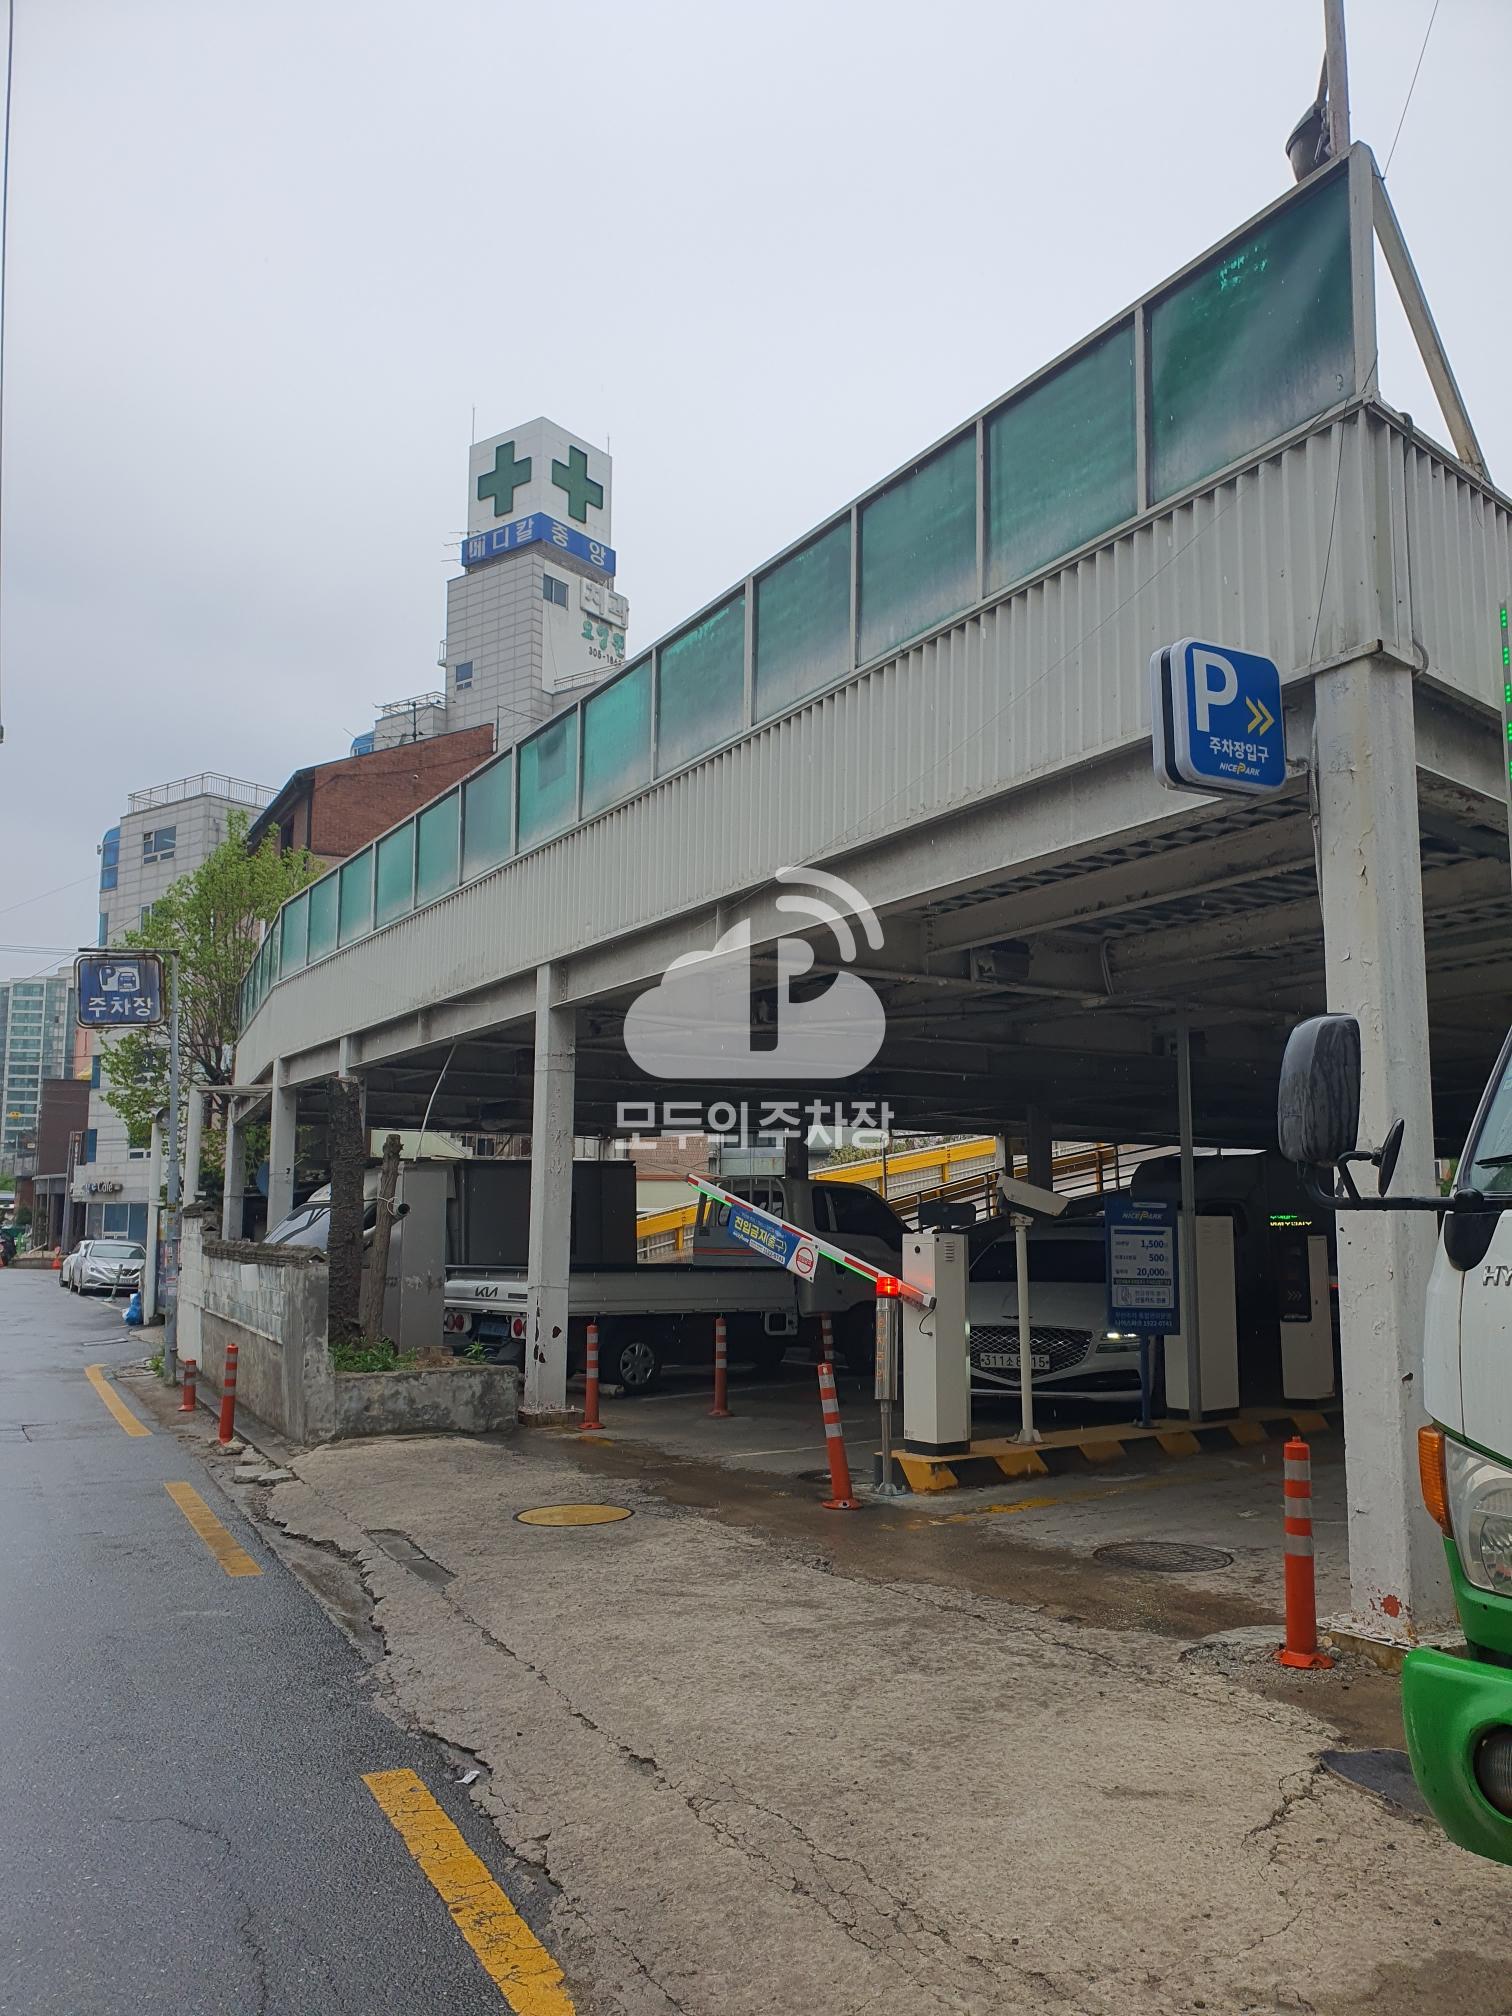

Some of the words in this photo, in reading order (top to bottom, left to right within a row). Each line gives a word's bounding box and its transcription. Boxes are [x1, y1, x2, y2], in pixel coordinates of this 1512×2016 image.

[468, 516, 534, 559] 메디칼
[551, 521, 606, 567] 중앙
[1192, 647, 1239, 734] P
[1209, 736, 1270, 764] 주차장입구
[1219, 762, 1261, 777] NICEPARK
[87, 996, 154, 1018] 주차장
[734, 1216, 788, 1255] 진입금지(출구)
[1136, 1267, 1165, 1278] 20,000
[1148, 1254, 1165, 1263] 500
